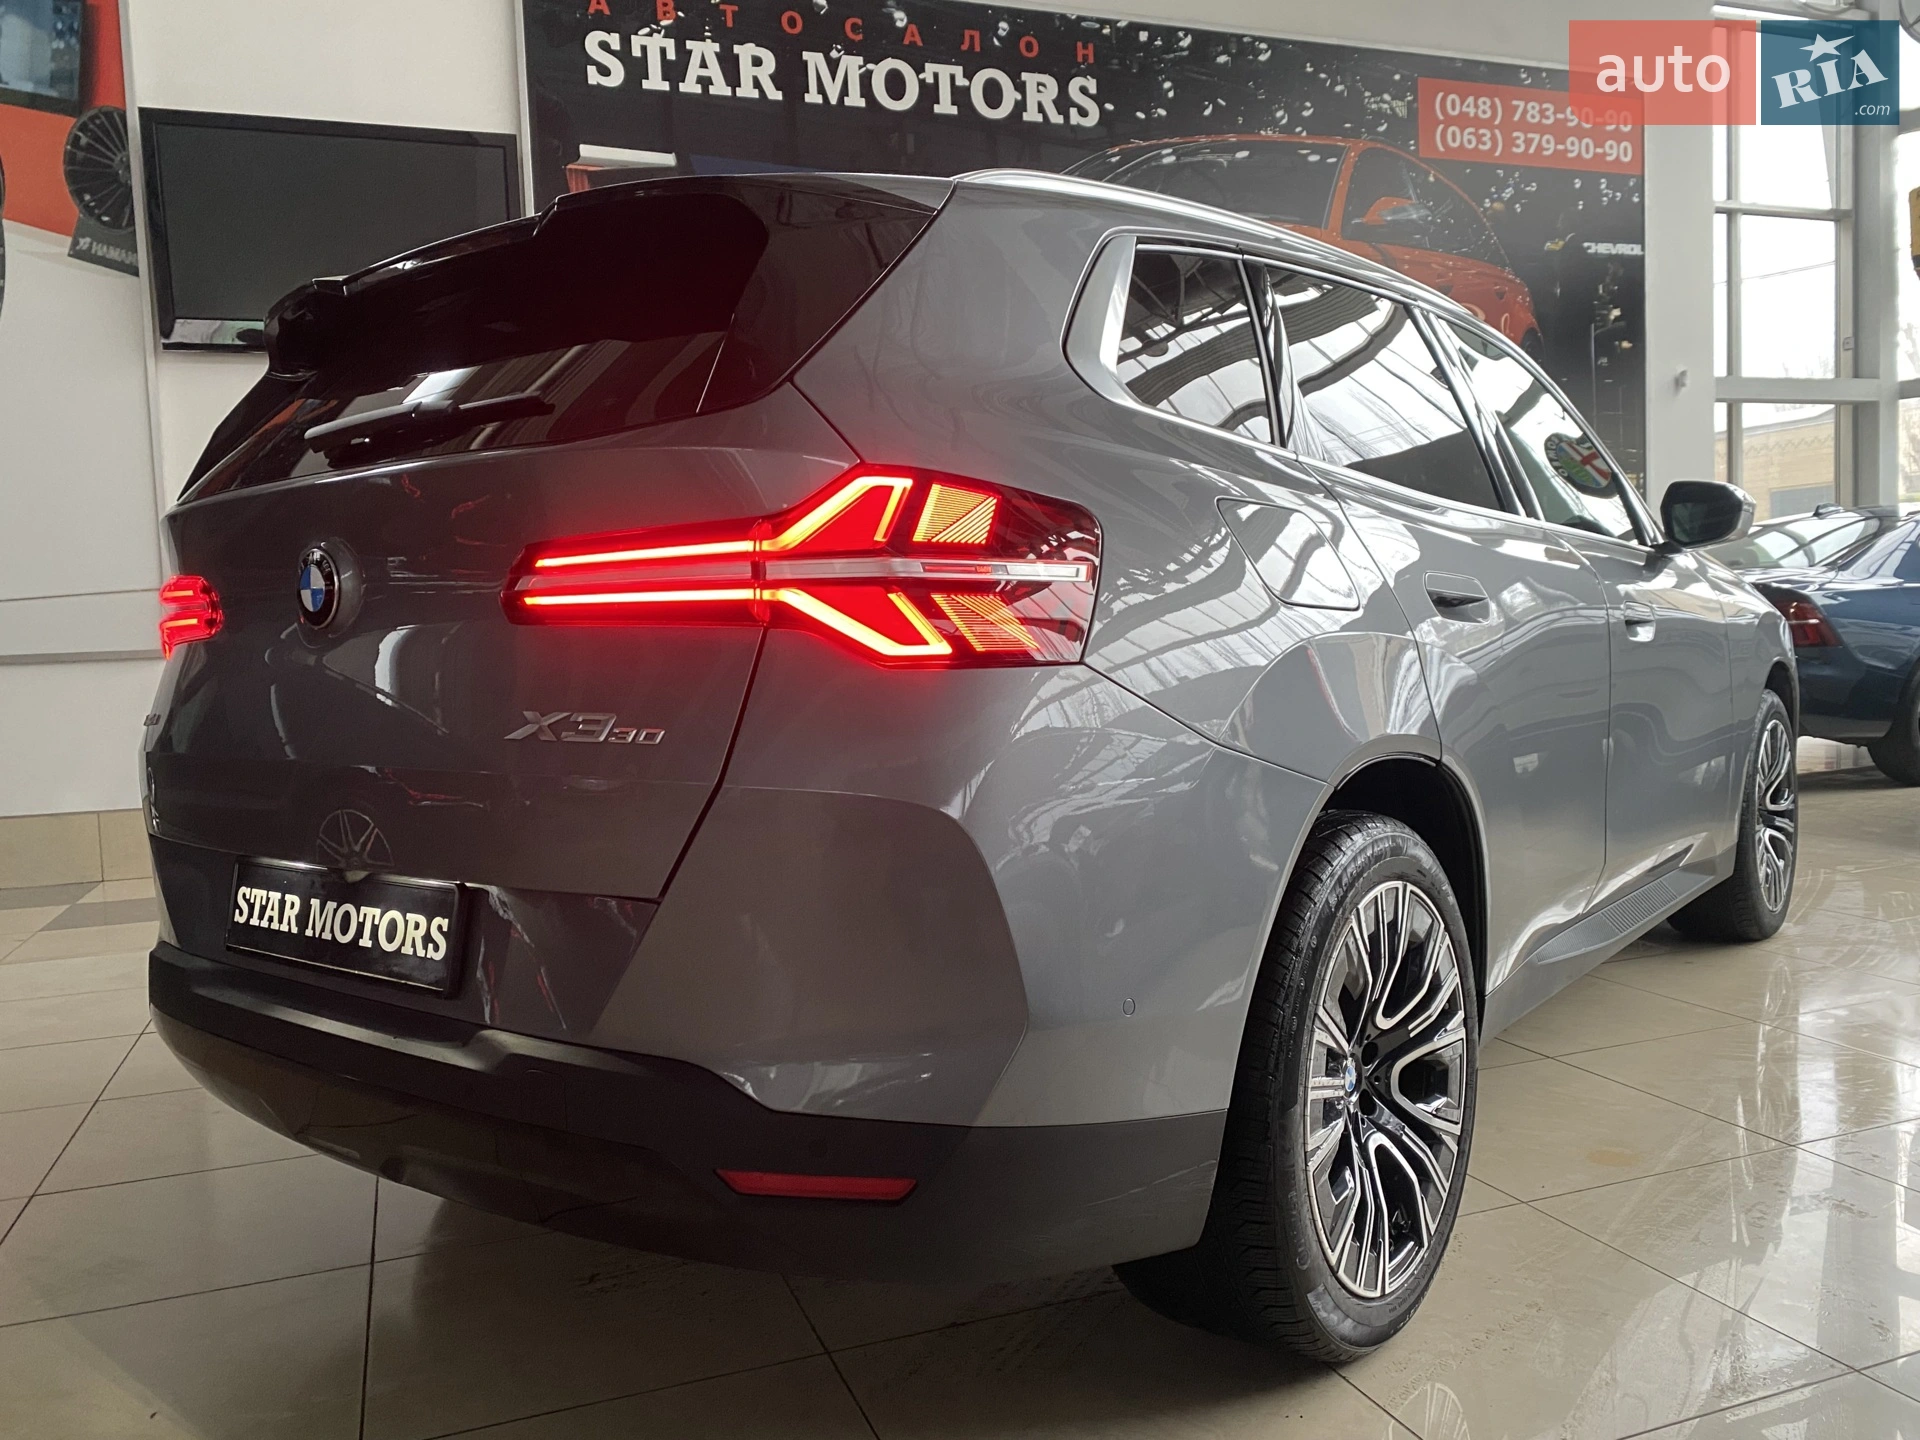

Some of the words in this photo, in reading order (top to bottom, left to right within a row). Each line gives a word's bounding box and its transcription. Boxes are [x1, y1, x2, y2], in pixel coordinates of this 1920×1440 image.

[588, 0, 1095, 64] АВТОСАЛОН
[584, 30, 783, 101] STAR
[802, 51, 1101, 127] MOTORS
[1435, 92, 1503, 125] (048)
[1511, 100, 1633, 132] 783-90-90
[1435, 124, 1503, 157] (063)
[1511, 131, 1633, 163] 379-90-90
[234, 886, 301, 934] STAR
[304, 898, 449, 961] MOTORS
